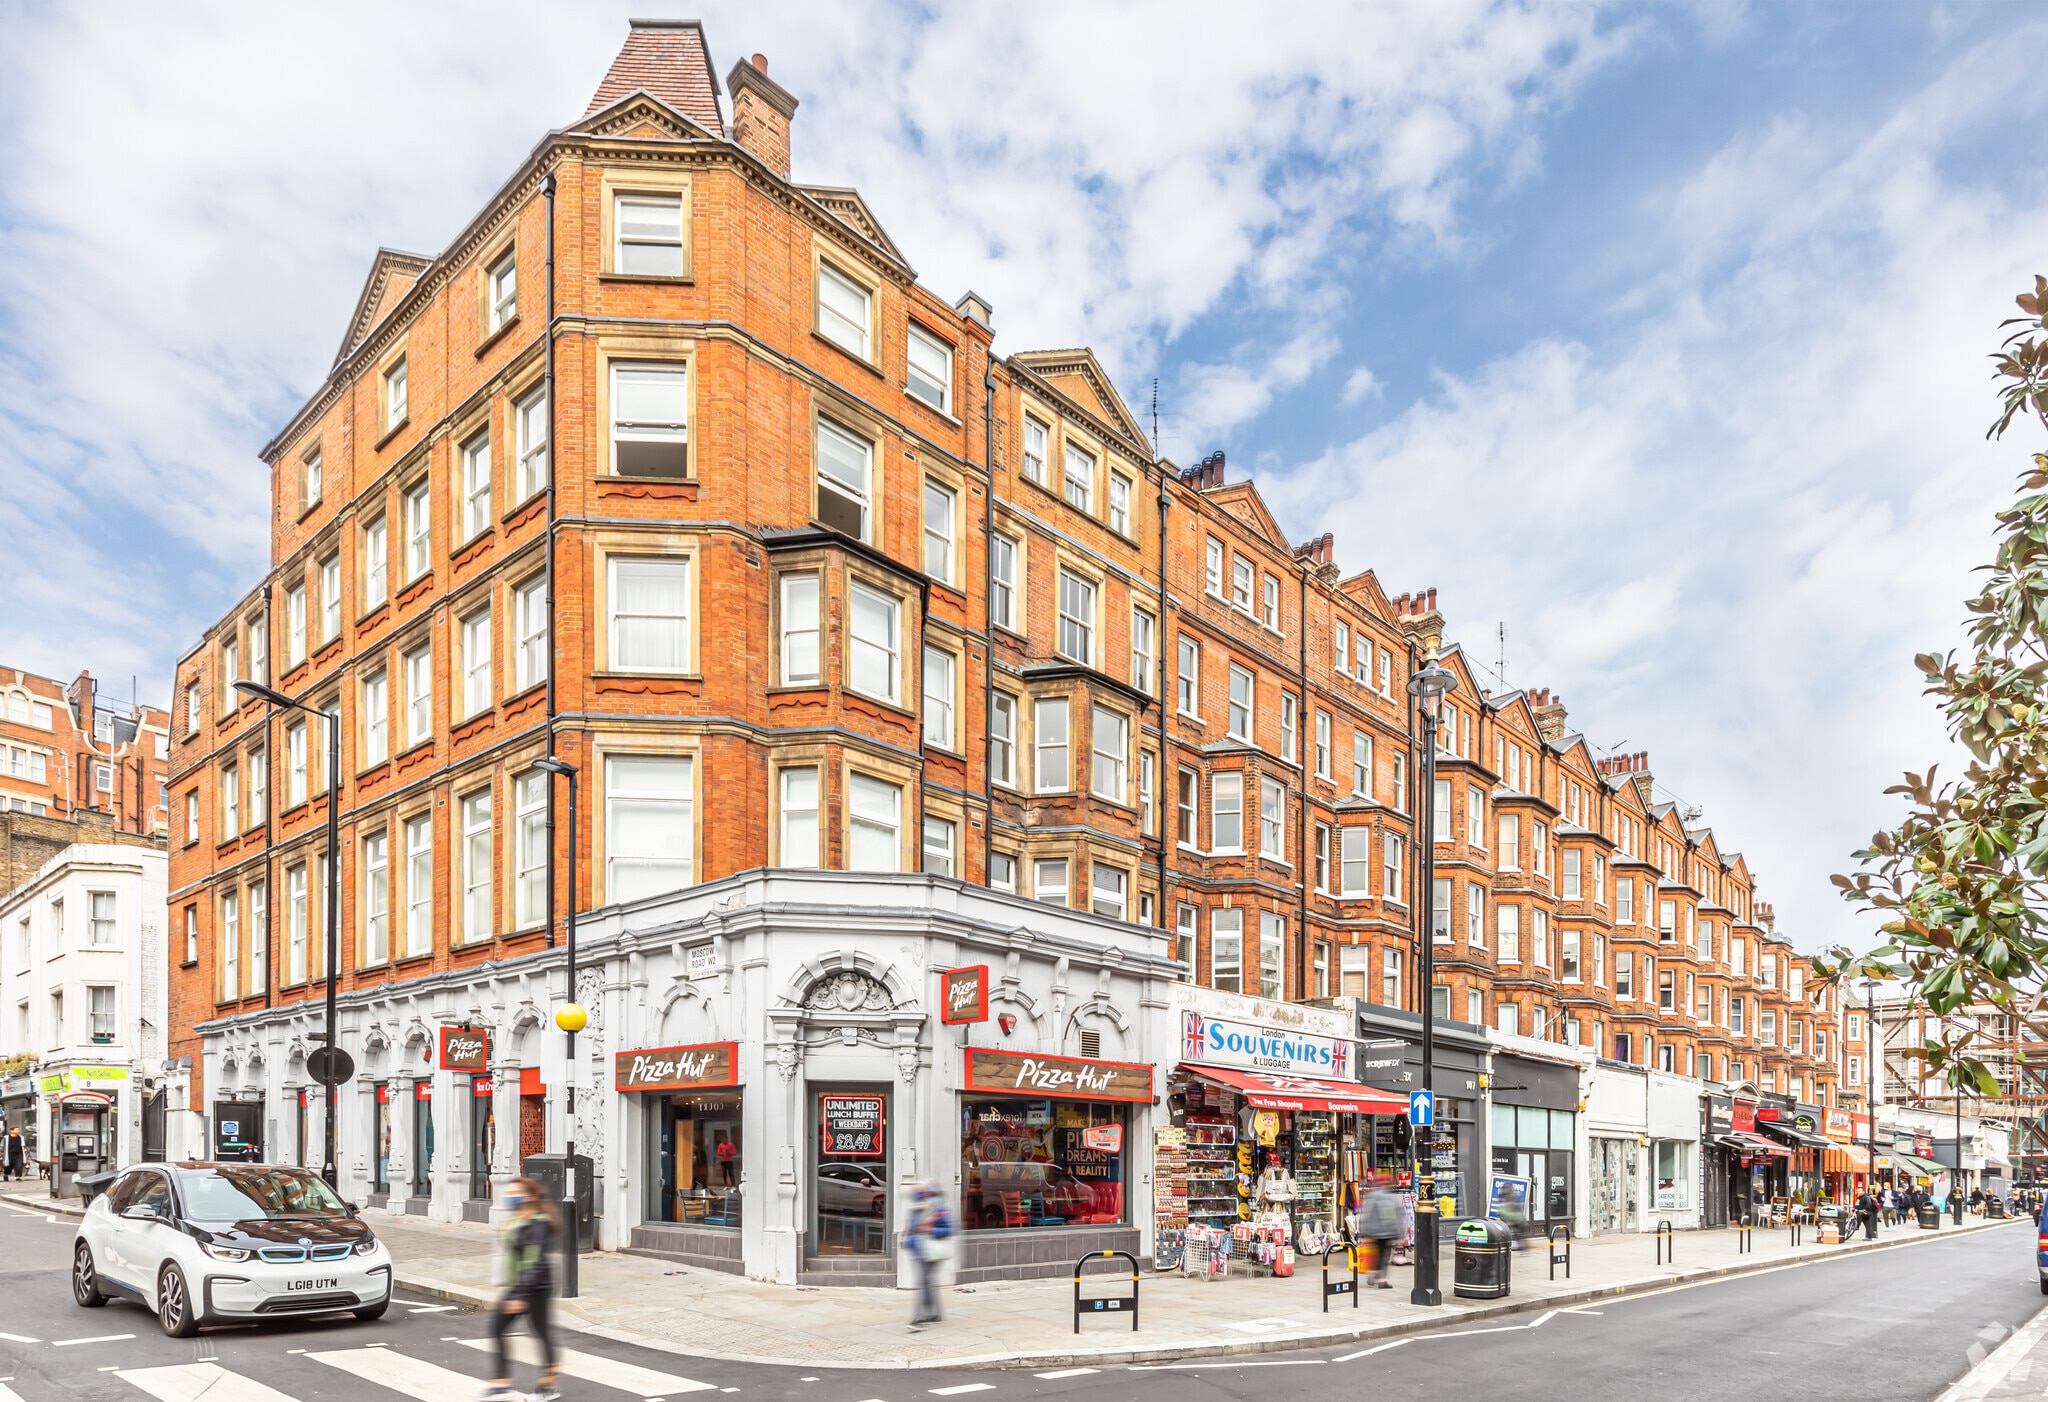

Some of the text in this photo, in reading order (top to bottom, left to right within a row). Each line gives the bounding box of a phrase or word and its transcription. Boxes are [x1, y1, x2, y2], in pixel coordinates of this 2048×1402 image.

[691, 946, 715, 958] MOSCOW
[692, 956, 716, 968] ROAD W2
[948, 980, 978, 1003] Pizza
[953, 990, 977, 1012] Hut
[1261, 1028, 1286, 1039] London
[447, 1037, 483, 1053] Pizza
[453, 1048, 481, 1062] Hut
[628, 1051, 715, 1086] Pizza Hut
[1253, 1056, 1291, 1070] & LUGGAGE
[1365, 1059, 1401, 1068] SCREWFIX
[1015, 1058, 1118, 1091] Pizza Hut
[476, 1082, 485, 1092] Ice
[1465, 1080, 1476, 1091] 107
[827, 1100, 879, 1110] UNLIMITED
[1251, 1097, 1303, 1110] Tax Free Shopping
[1327, 1101, 1359, 1112] Souvenirs
[827, 1110, 879, 1119] LUNCH BUFFET
[838, 1120, 868, 1128] WEEKDAYS
[1066, 1119, 1087, 1128] MAKE
[836, 1133, 871, 1150] £8.49
[1066, 1149, 1108, 1162] DREAMS
[1067, 1165, 1107, 1177] A REALITY
[1495, 1181, 1525, 1192] OPING
[1236, 1226, 1247, 1239] £1
[1274, 1231, 1282, 1242] £1
[287, 1278, 338, 1291] LG18 UTM
